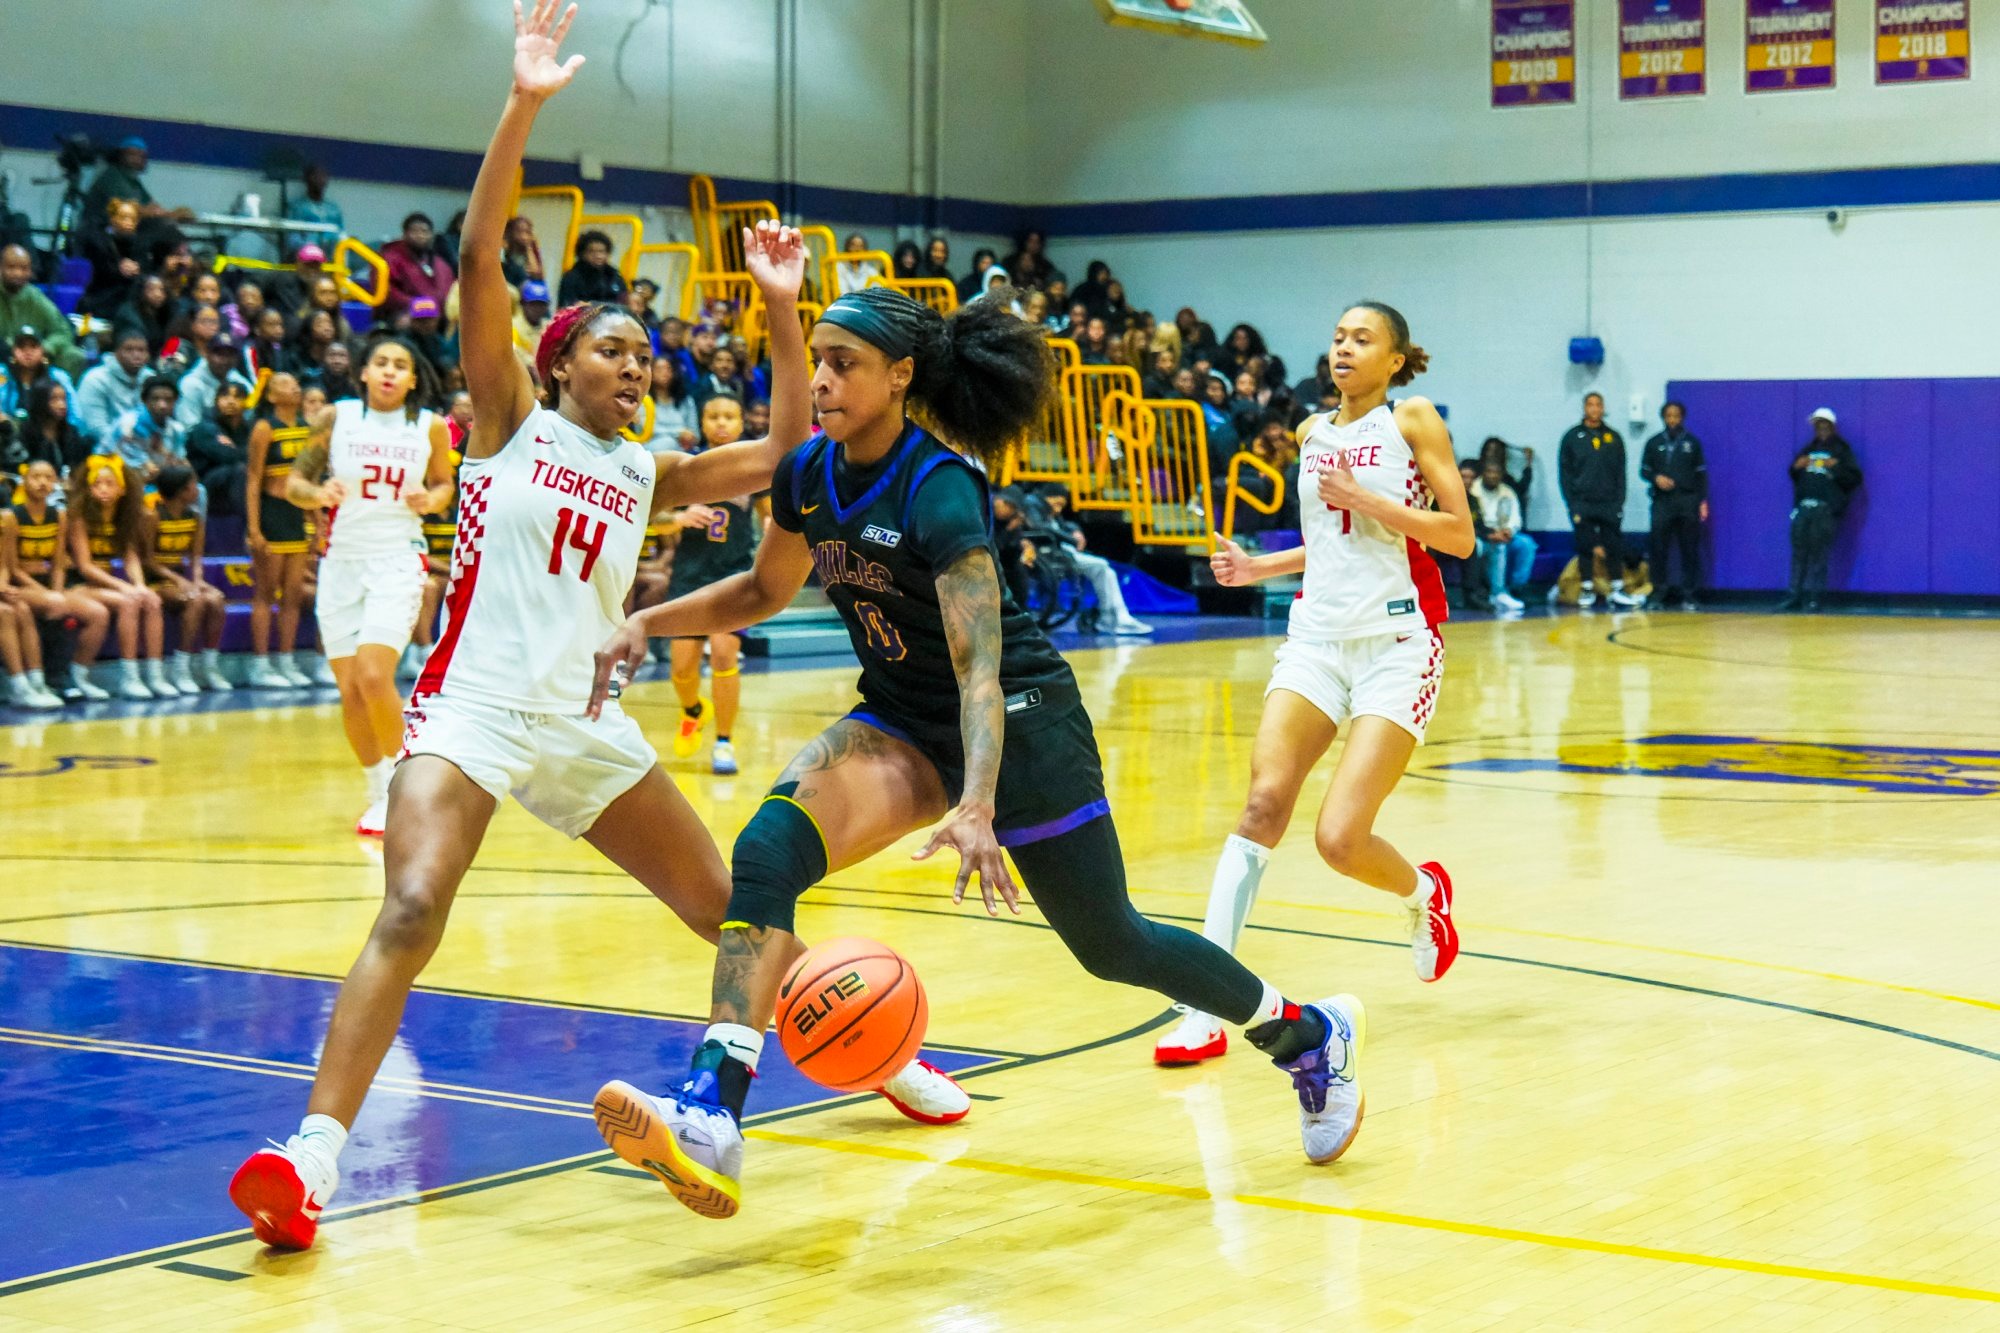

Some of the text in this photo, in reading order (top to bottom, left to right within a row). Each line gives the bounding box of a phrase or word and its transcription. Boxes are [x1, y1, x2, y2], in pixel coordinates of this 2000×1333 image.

[1765, 45, 1812, 68] 2012
[1898, 35, 1947, 59] 2018
[1508, 60, 1558, 83] 2009
[1639, 53, 1684, 75] 2012
[361, 464, 405, 501] 24
[531, 459, 638, 525] TUSKEGEE
[708, 506, 730, 542] 2
[863, 525, 900, 547] SIAC
[548, 507, 608, 583] 14
[854, 601, 908, 661] 0
[1029, 694, 1037, 703] L
[793, 971, 866, 1036] ELITE
